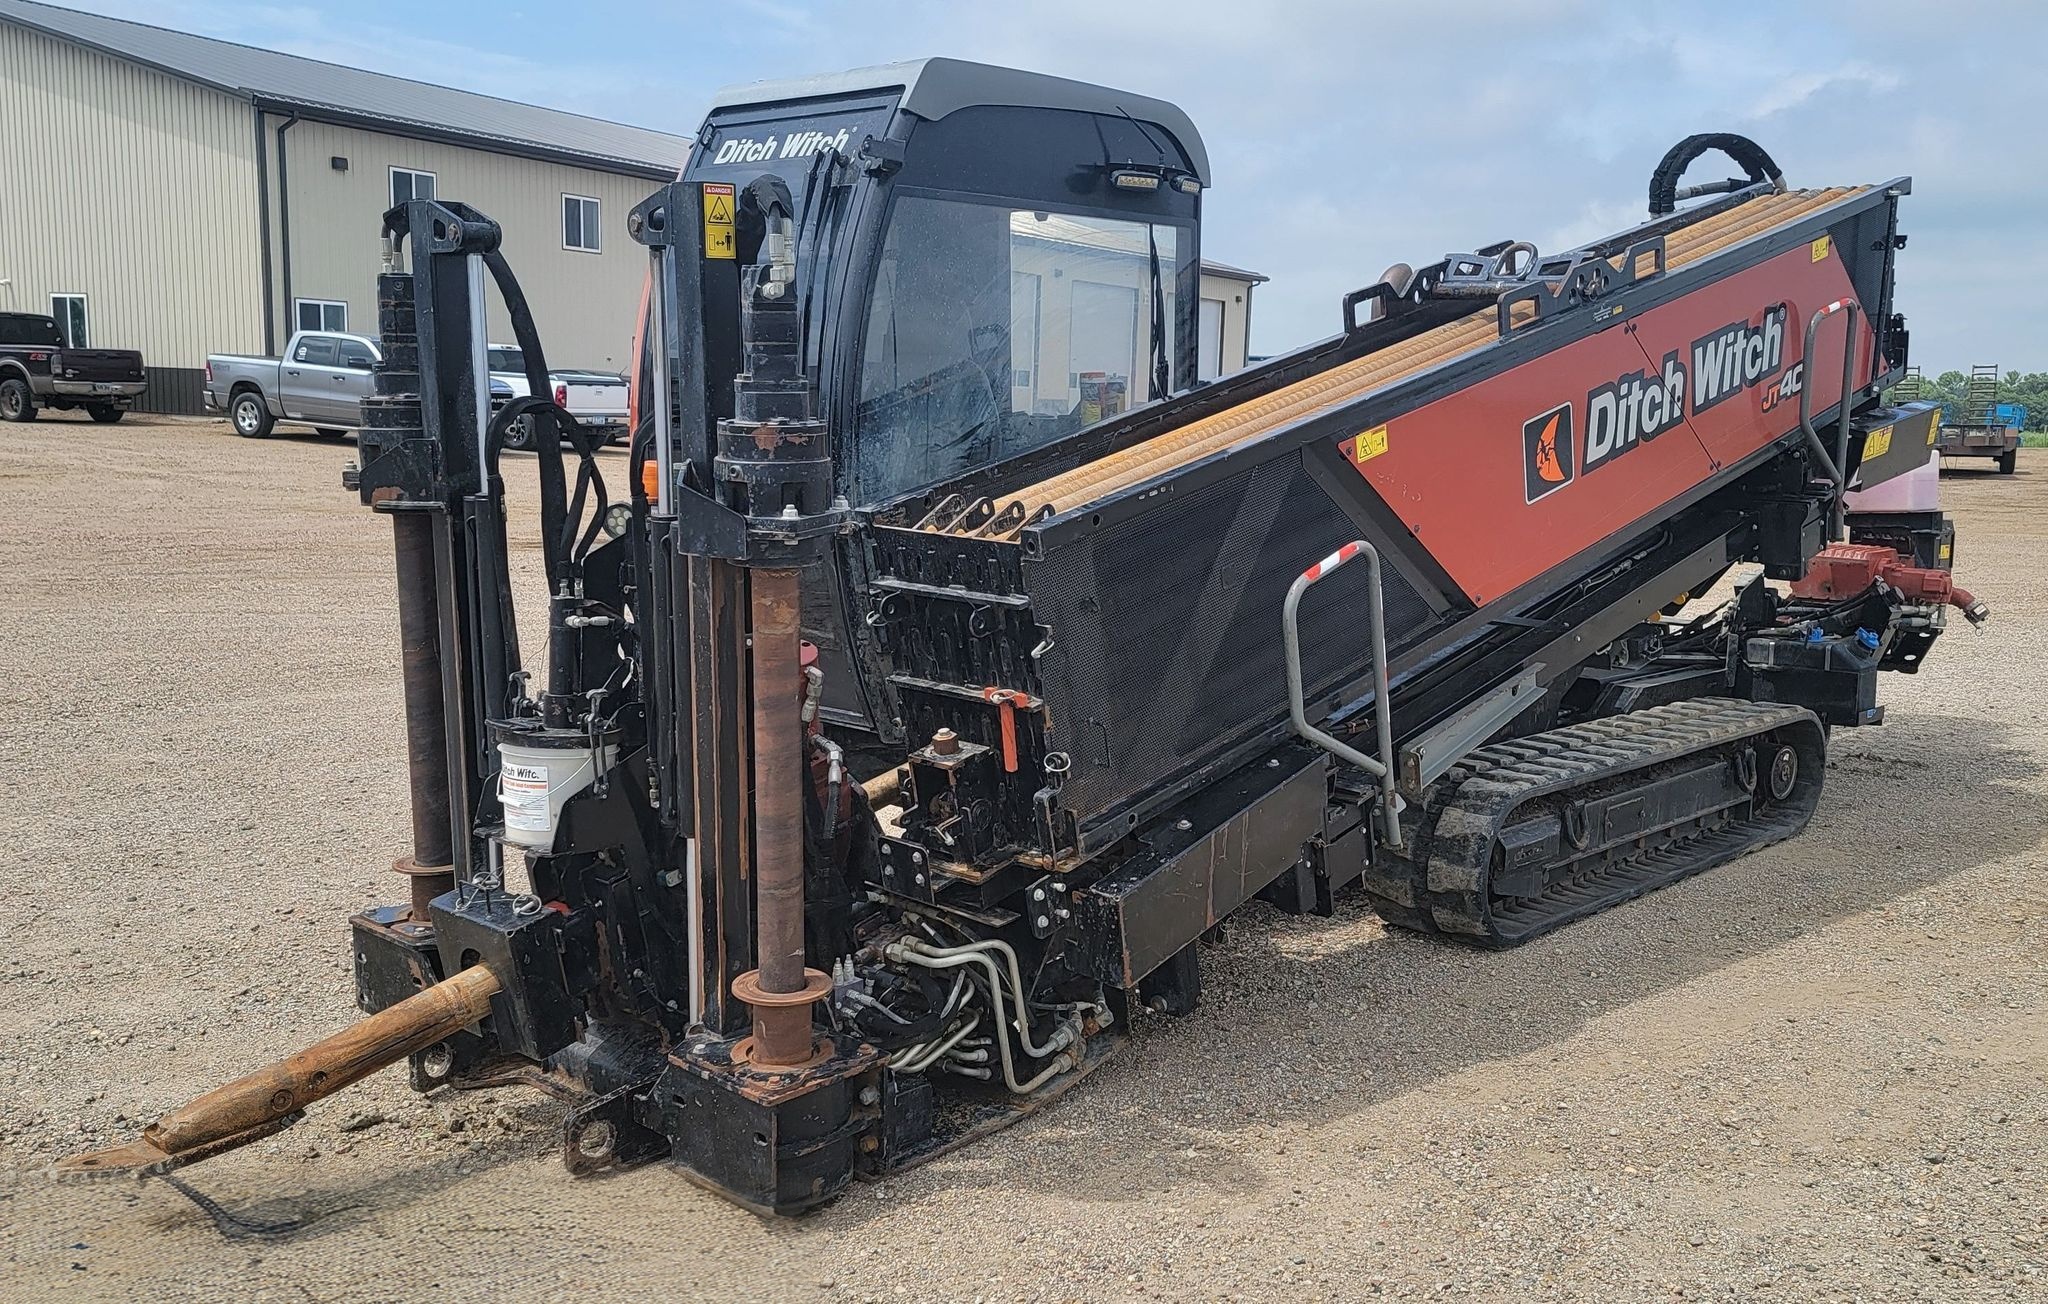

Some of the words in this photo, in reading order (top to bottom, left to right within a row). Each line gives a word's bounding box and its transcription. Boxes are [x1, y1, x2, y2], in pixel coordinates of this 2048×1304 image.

[713, 135, 778, 165] Ditch
[779, 128, 850, 159] Witch
[711, 186, 732, 195] DANGER
[1586, 360, 1683, 465] Ditch
[1694, 312, 1782, 408] Witch
[516, 767, 540, 780] Witc
